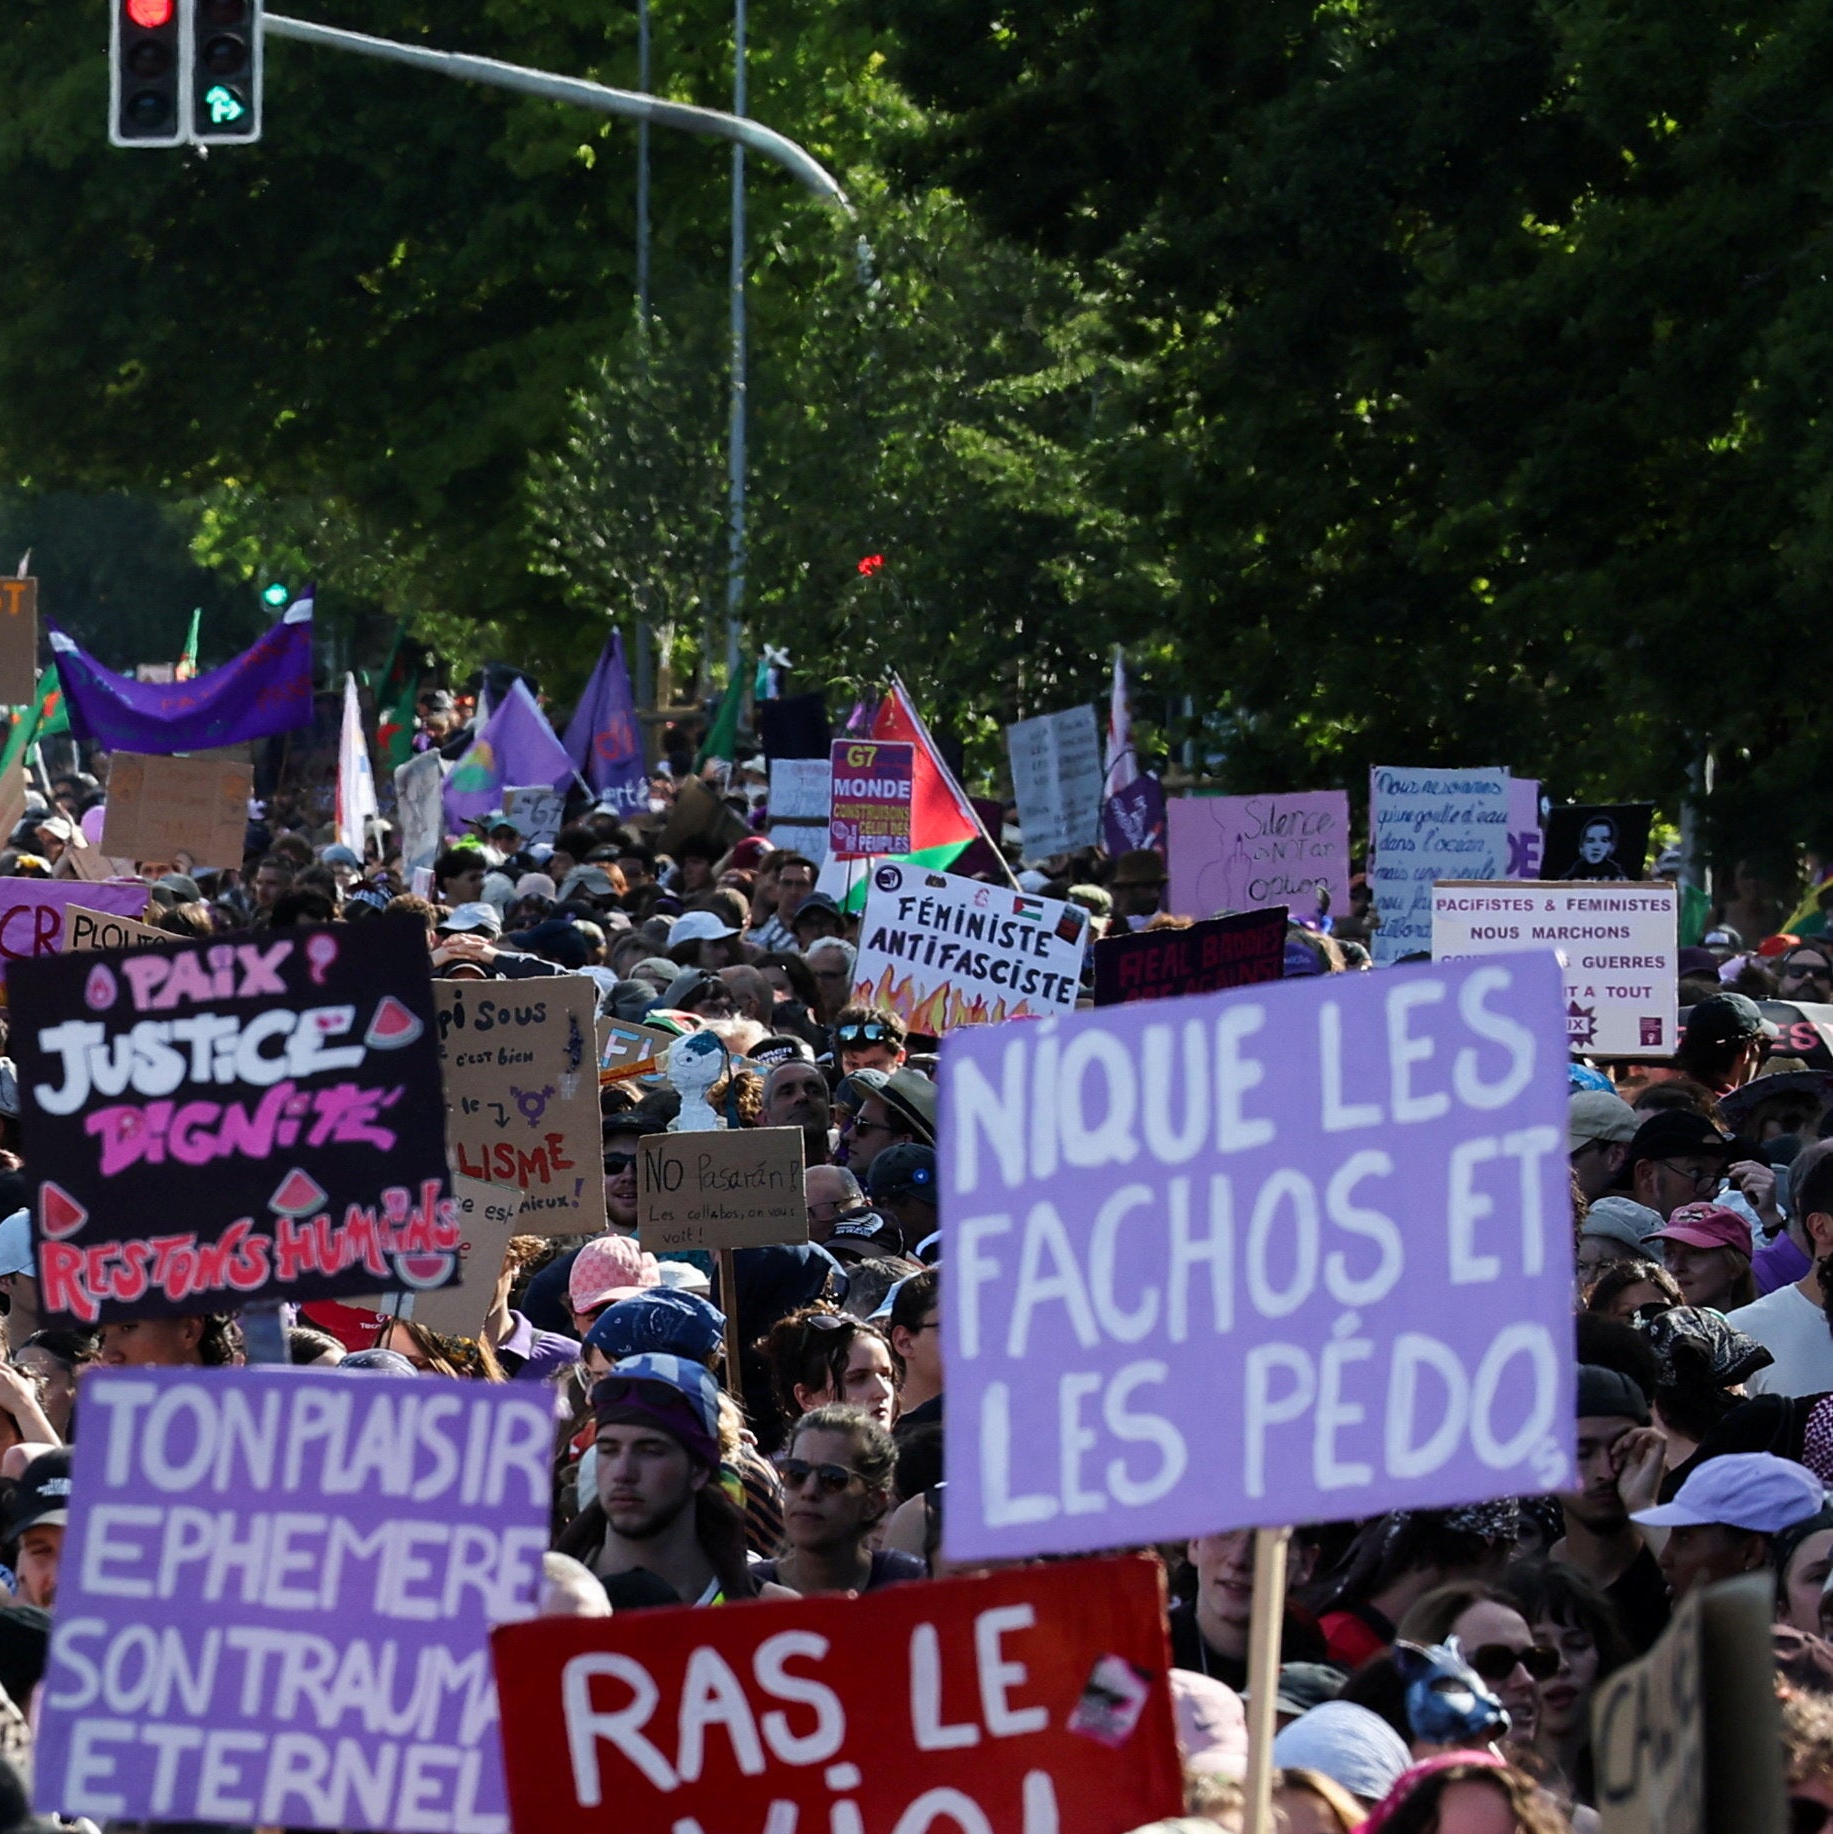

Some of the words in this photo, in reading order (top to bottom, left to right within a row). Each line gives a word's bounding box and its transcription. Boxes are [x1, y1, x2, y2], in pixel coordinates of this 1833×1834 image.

[847, 745, 878, 768] G7
[834, 778, 910, 799] MONDE
[890, 821, 909, 836] DES
[1245, 801, 1332, 841] Silence
[859, 835, 909, 853] PEUPLES
[1273, 839, 1306, 864] NOT
[1544, 899, 1556, 911] &
[1471, 926, 1520, 939] NOUS
[1532, 926, 1631, 939] MARCHONS
[1119, 943, 1193, 988] REAL
[1201, 922, 1282, 970] BADDIES
[1582, 956, 1666, 968] GUERRES
[1584, 987, 1596, 998] A
[1606, 986, 1653, 998] TOUT
[1319, 966, 1537, 1132] LES
[645, 1148, 682, 1194] NO
[649, 1203, 675, 1222] Les
[748, 1207, 764, 1218] on
[767, 1207, 796, 1218] vous
[958, 1151, 1404, 1360] FACHOS
[1448, 1124, 1561, 1286] ET
[38, 1217, 273, 1324] RESTONS
[91, 1381, 281, 1494] TON
[283, 1387, 553, 1509] PLAISIR
[980, 1359, 1189, 1528] LES
[80, 1504, 550, 1623] EPHEMERE
[49, 1617, 221, 1718] SON
[561, 1628, 848, 1807] RAS
[911, 1603, 1050, 1751] LE
